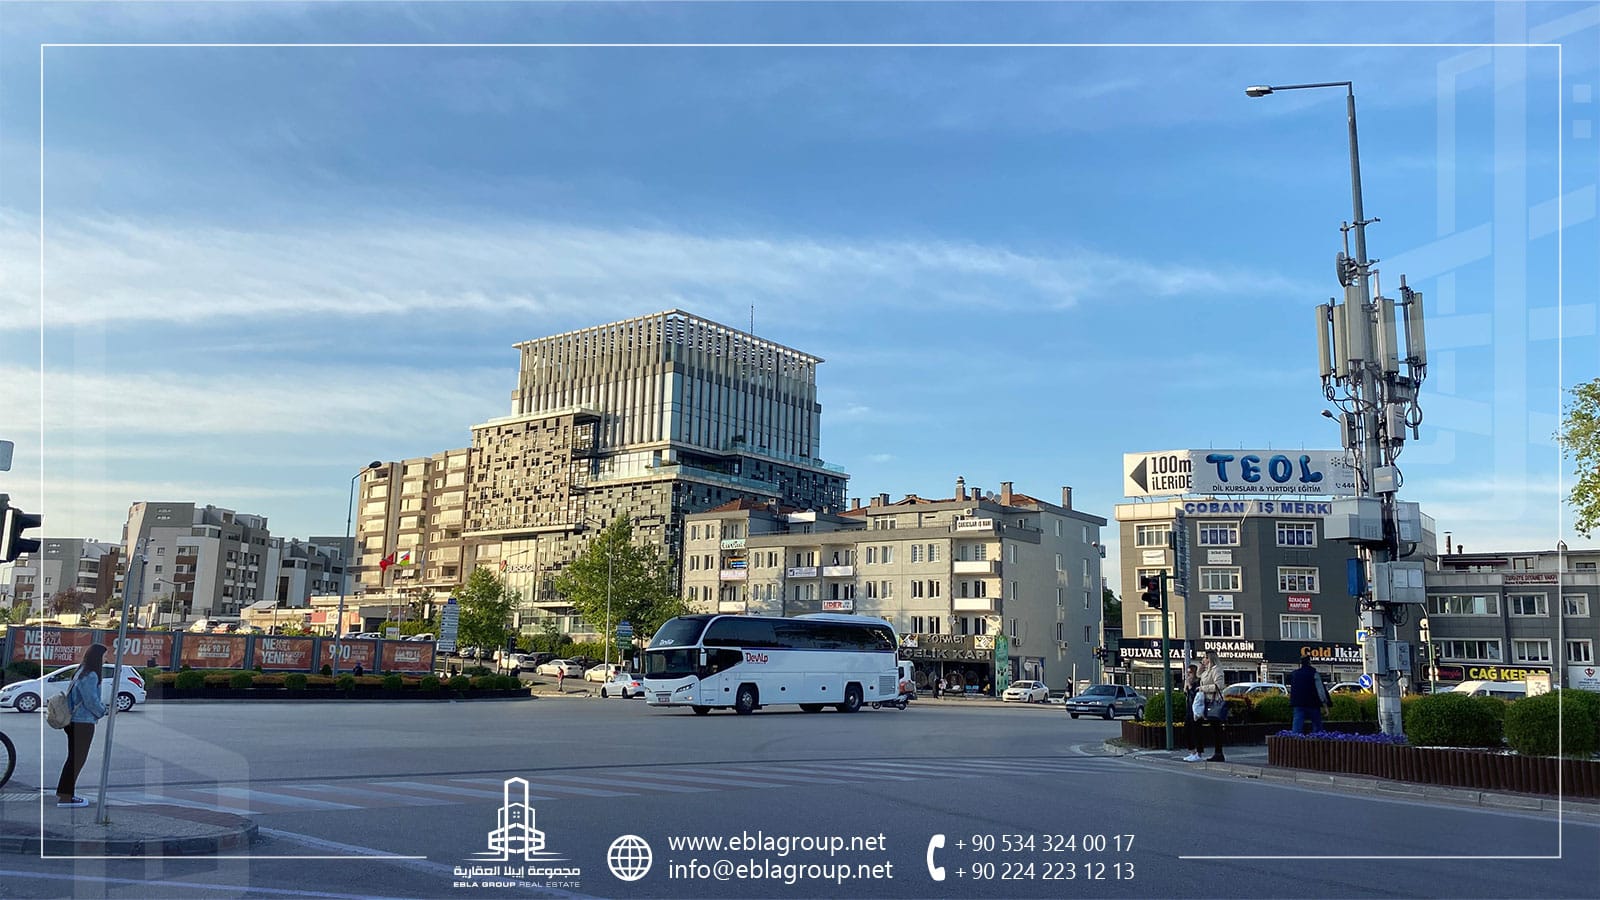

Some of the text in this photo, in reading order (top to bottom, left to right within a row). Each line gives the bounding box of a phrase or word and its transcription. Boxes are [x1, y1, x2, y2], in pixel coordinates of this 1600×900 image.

[1152, 455, 1191, 474] 100m
[1206, 453, 1323, 483] TEOL
[1185, 502, 1332, 514] ÇOBAN İŞ MERK
[1205, 640, 1254, 652] DUŞAKABİN
[1301, 646, 1332, 657] Gold
[904, 647, 992, 660] ÇELİK KAPI
[1120, 647, 1162, 658] BULVAR
[1469, 666, 1497, 680] CAĞ
